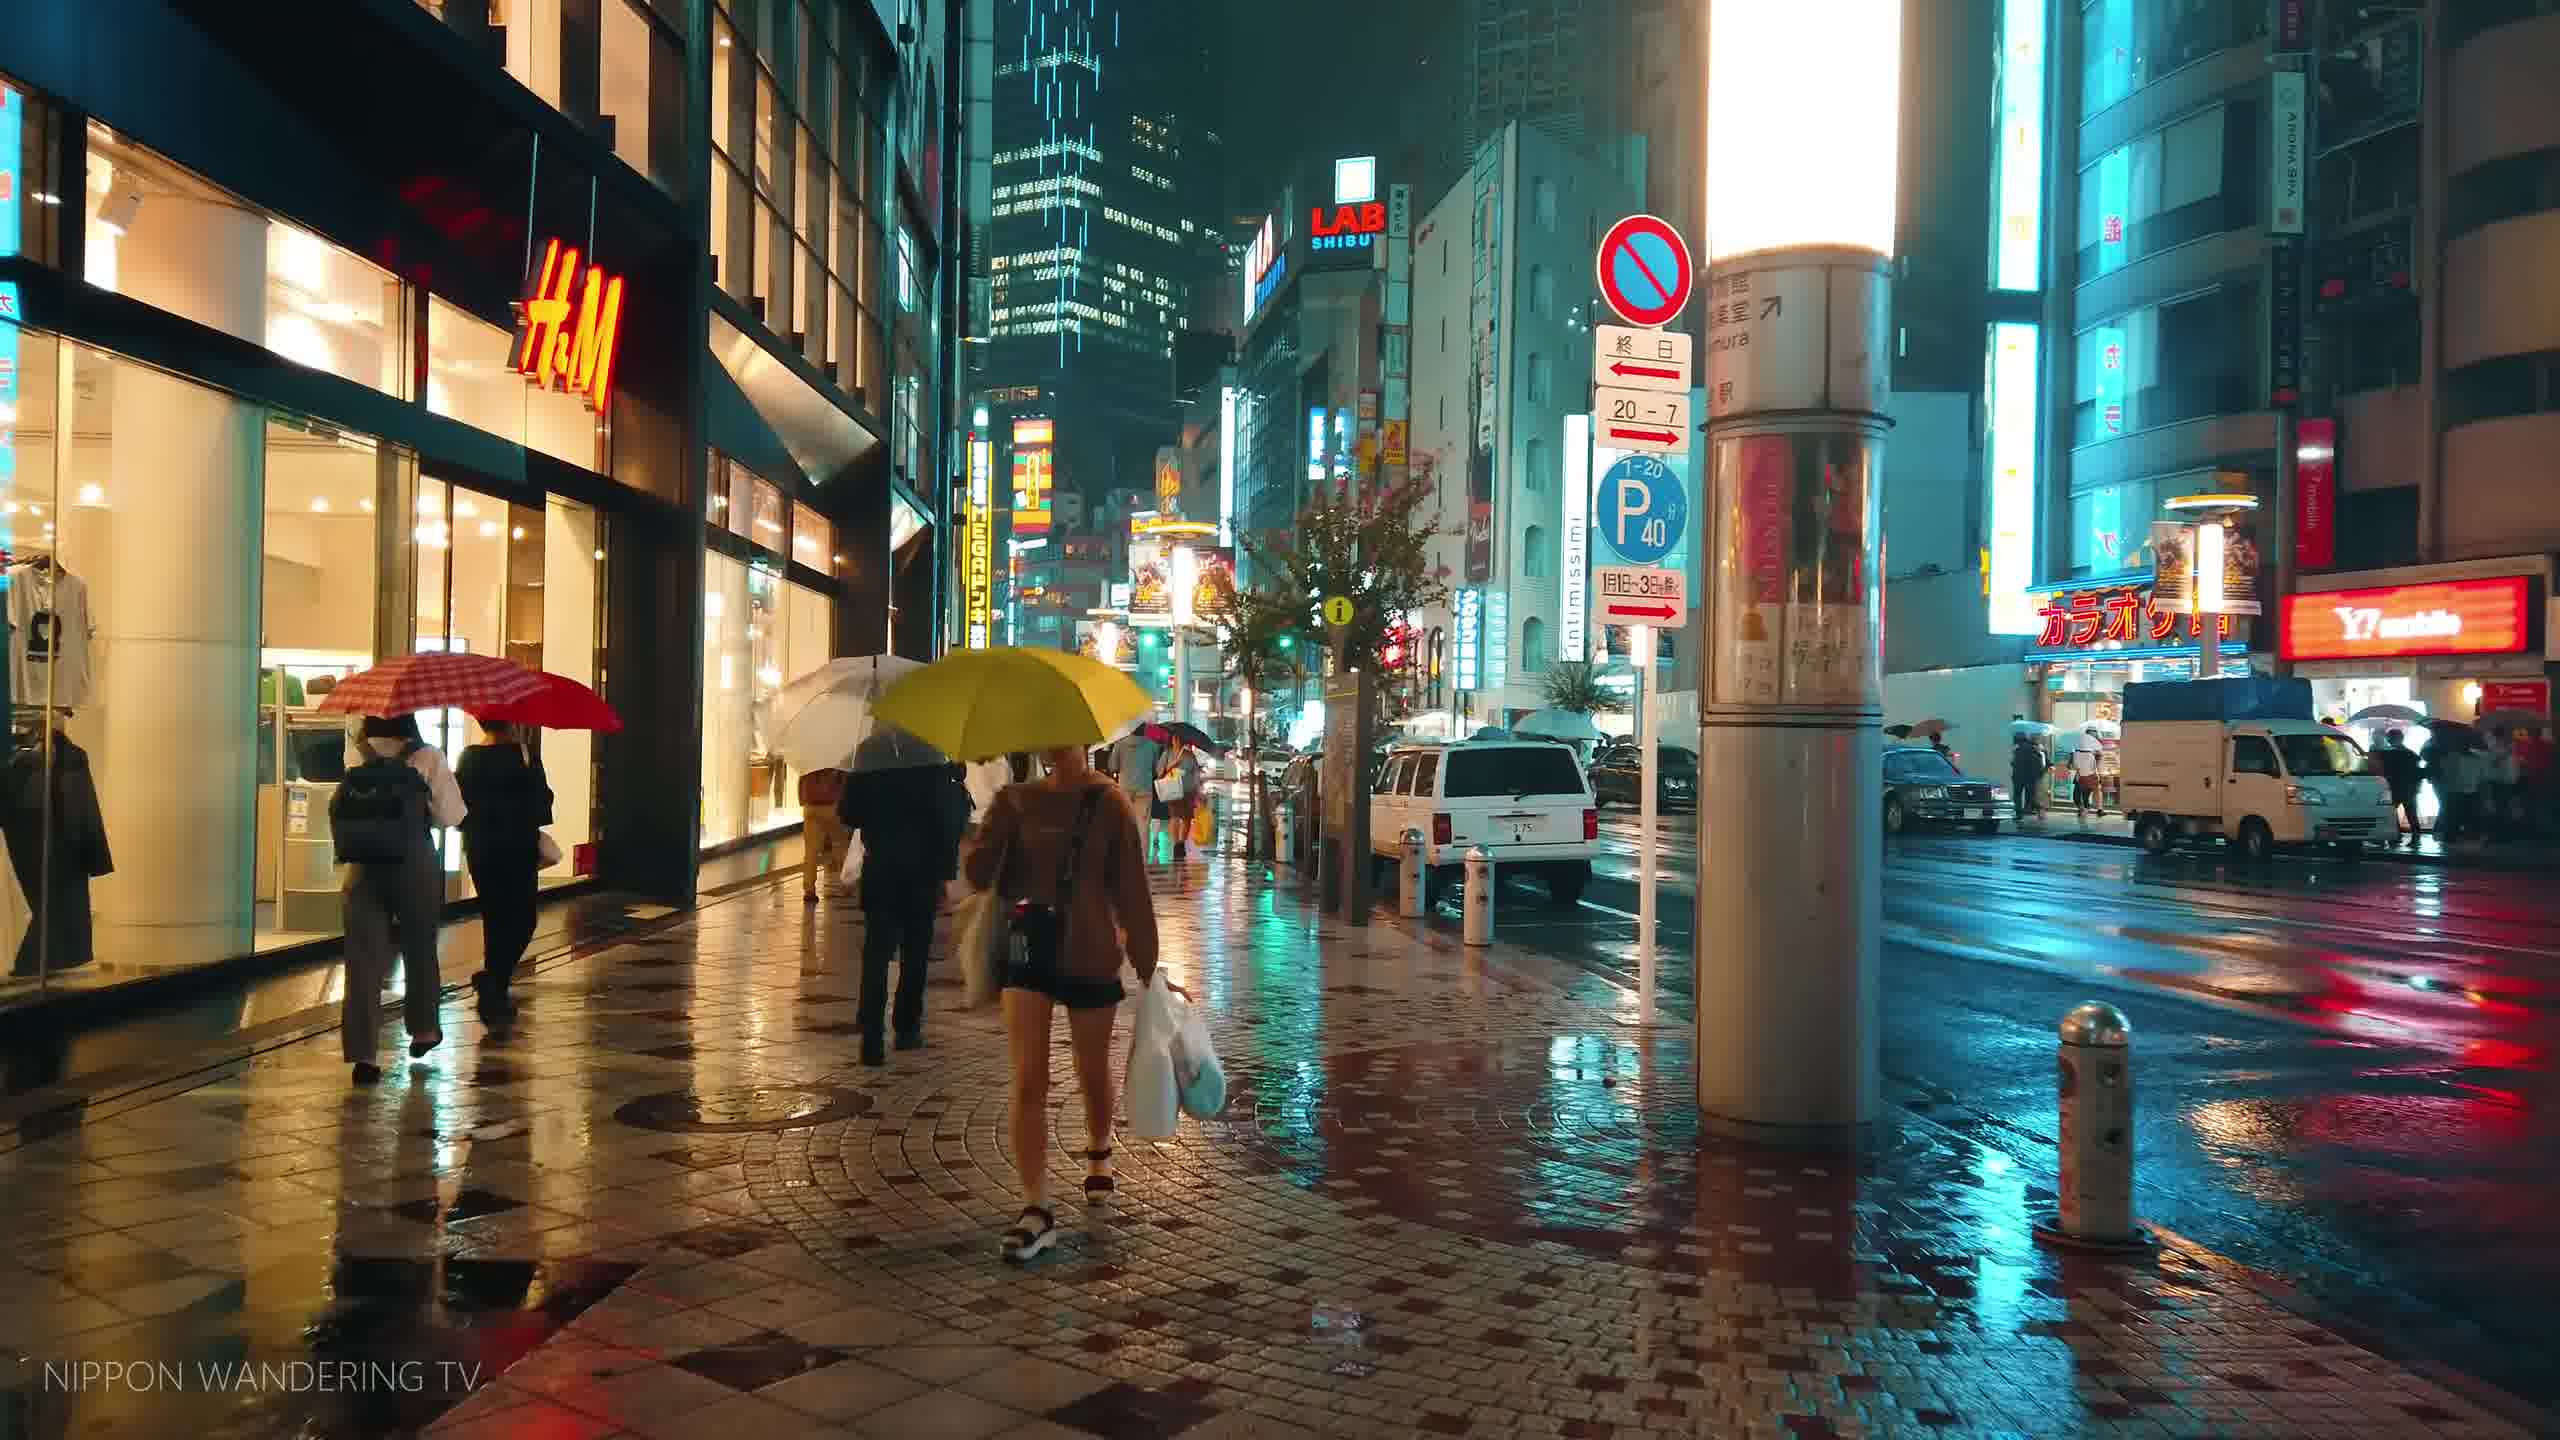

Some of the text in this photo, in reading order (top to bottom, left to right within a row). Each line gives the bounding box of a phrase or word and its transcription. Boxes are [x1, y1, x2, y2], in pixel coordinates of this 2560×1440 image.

[1312, 233, 1375, 249] SHIBU
[519, 236, 624, 416] H&M
[1616, 336, 1672, 359] 終日
[1614, 399, 1637, 419] 20
[1666, 404, 1678, 424] 7
[1617, 479, 1651, 545] P
[1641, 518, 1666, 548] 40
